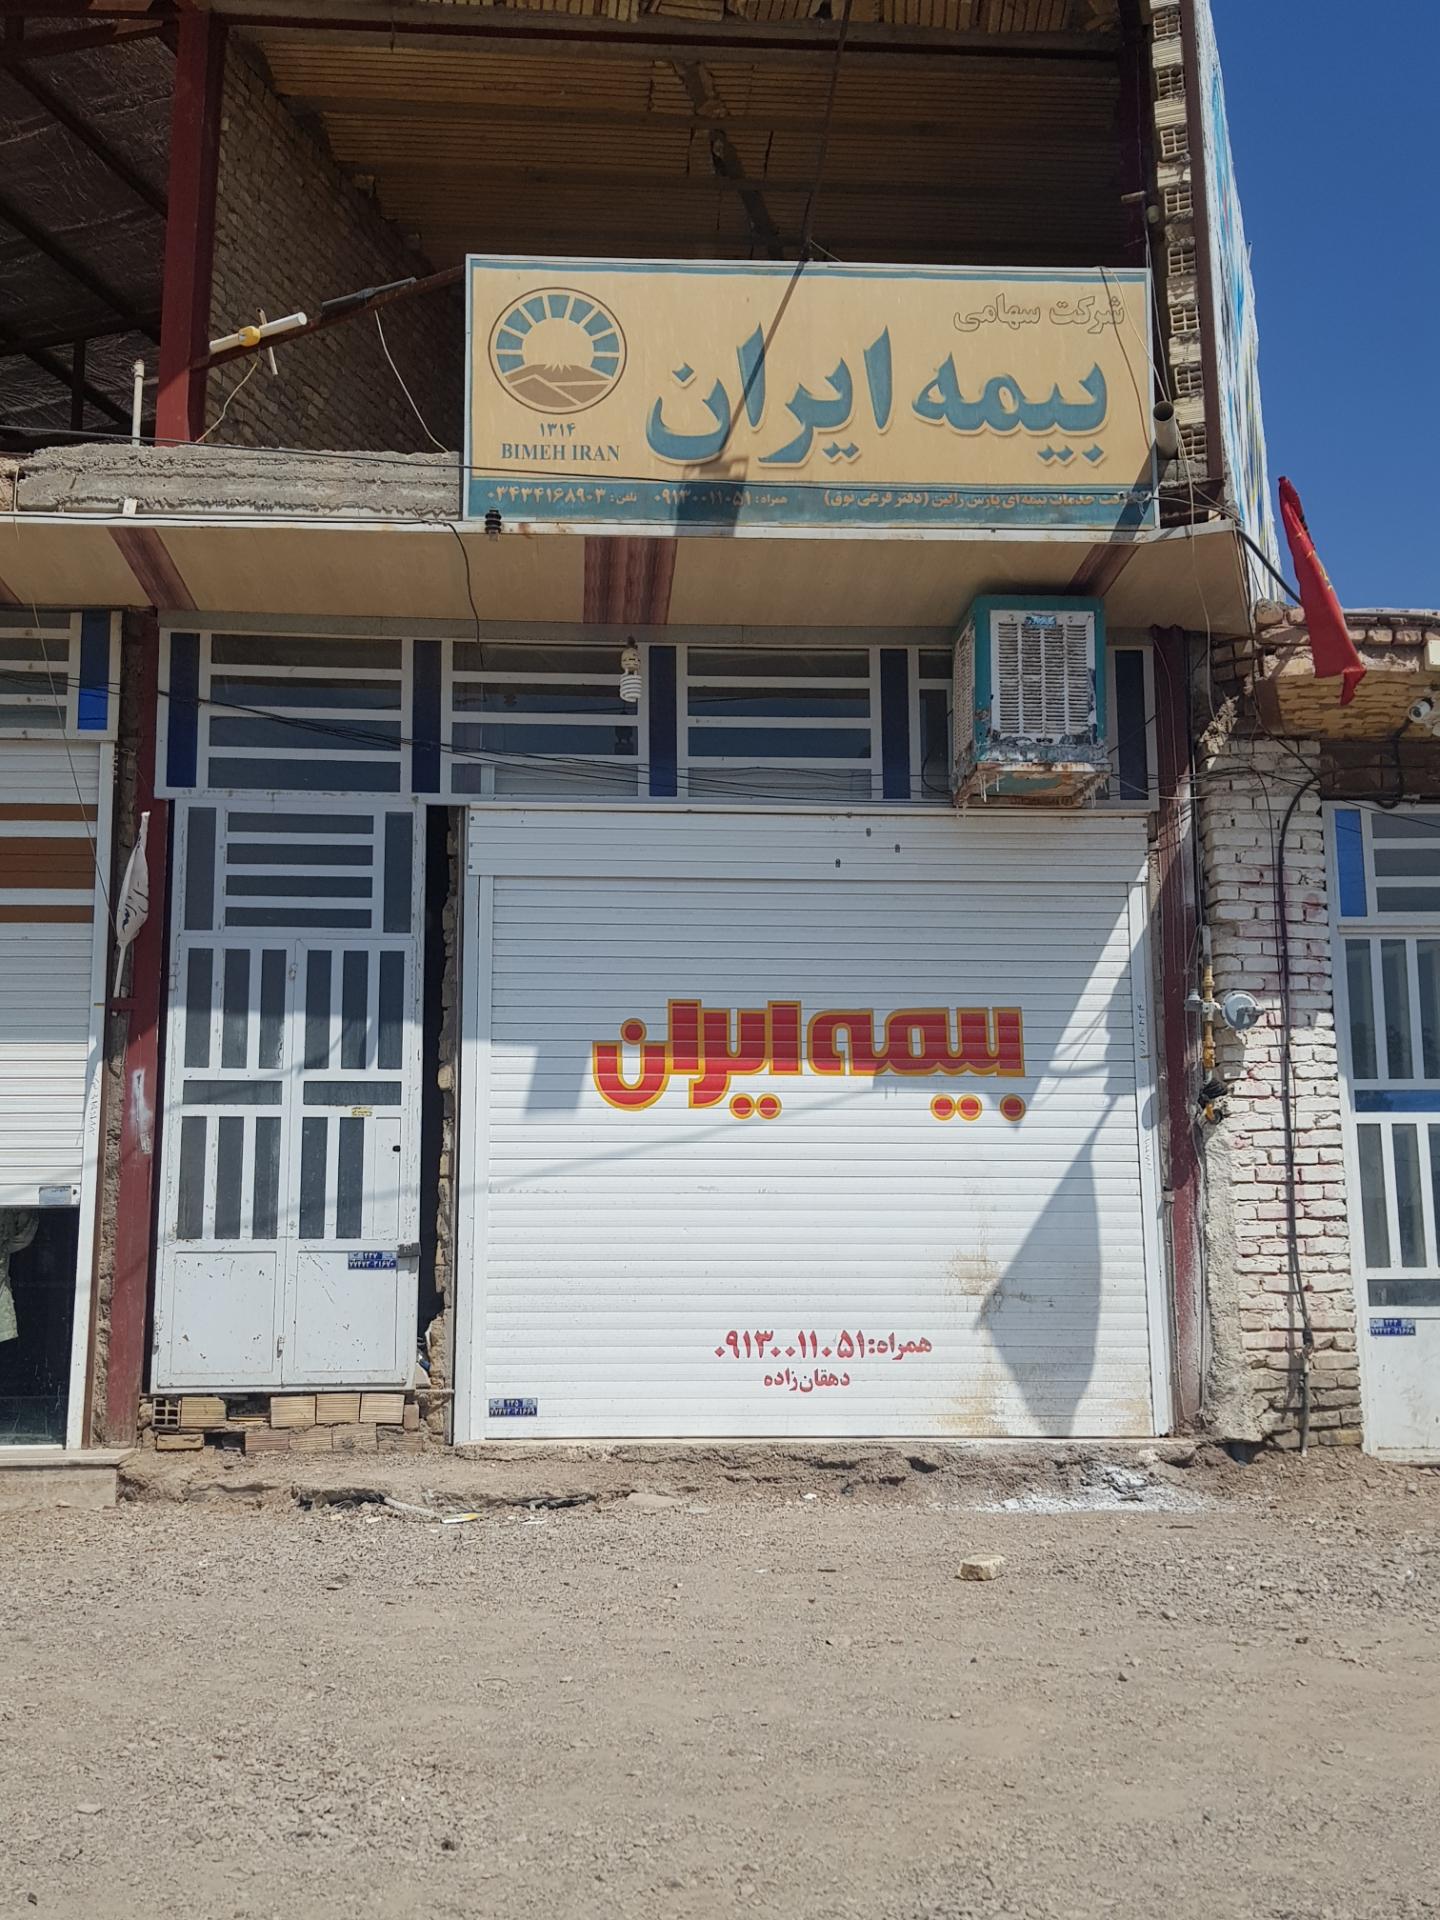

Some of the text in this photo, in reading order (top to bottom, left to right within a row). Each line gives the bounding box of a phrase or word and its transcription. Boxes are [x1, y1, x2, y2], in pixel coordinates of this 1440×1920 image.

[953, 293, 1125, 334] شرکت سهامی
[540, 422, 576, 437] ۱۳۱۴
[647, 321, 1109, 467] بیمه ایران
[502, 443, 620, 461] BIMEH IRAN
[592, 998, 802, 1120] ایران
[807, 1006, 1026, 1121] بیمه
